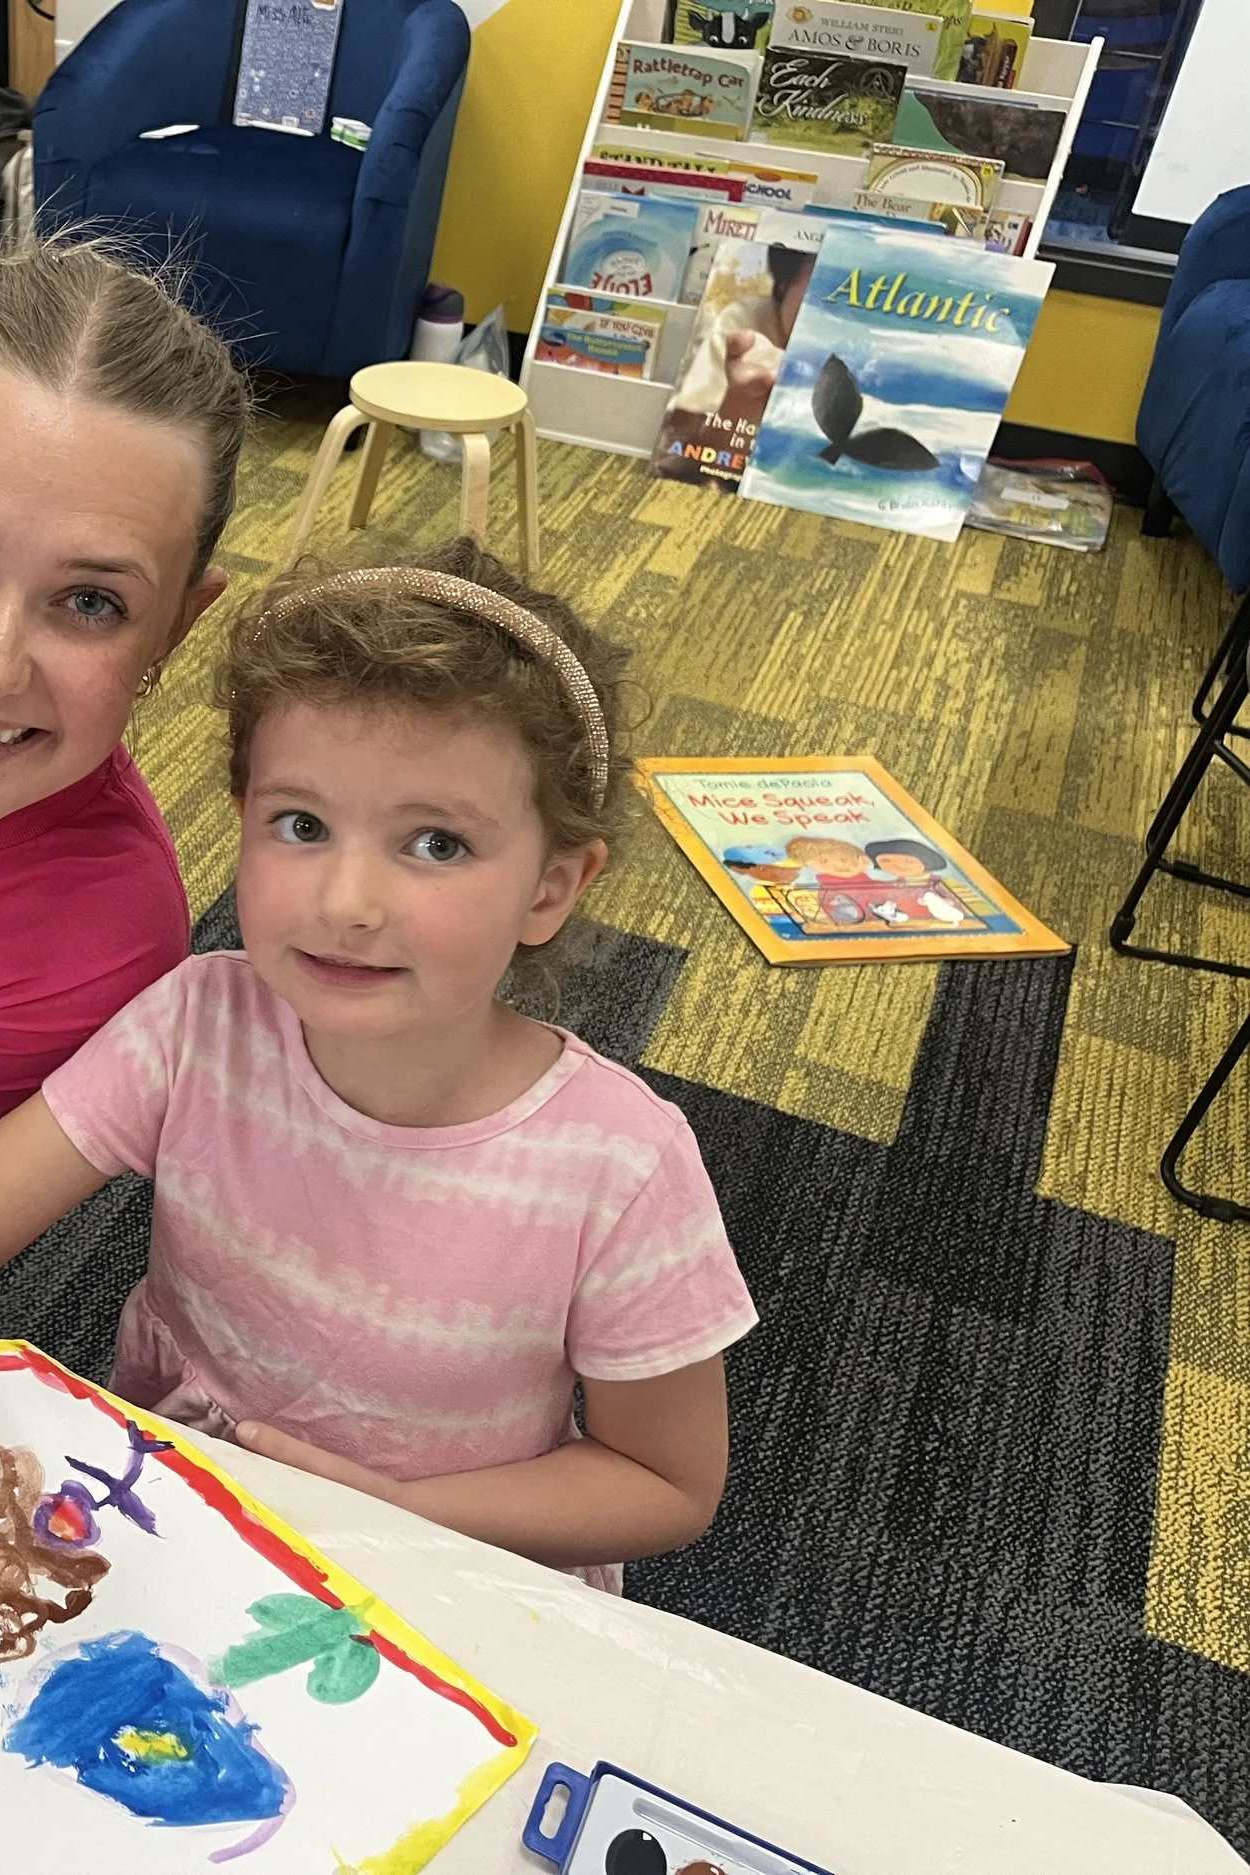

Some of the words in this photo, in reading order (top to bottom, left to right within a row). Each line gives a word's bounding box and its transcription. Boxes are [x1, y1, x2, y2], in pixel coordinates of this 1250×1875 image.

[820, 17, 869, 31] WILLIAM
[788, 28, 841, 47] AMOS
[845, 34, 864, 51] &
[867, 38, 921, 58] BORIS
[633, 57, 713, 87] Rattletrap
[718, 73, 745, 88] Car
[770, 58, 843, 89] Each
[757, 88, 868, 126] Kindness
[854, 193, 877, 208] The
[882, 198, 912, 212] Bear
[823, 266, 1011, 334] Atlantic
[599, 318, 611, 329] IF
[612, 320, 630, 332] YOU
[631, 323, 655, 338] GIVE
[705, 412, 733, 431] The
[730, 433, 745, 448] in
[667, 441, 748, 470] ANDRE
[693, 778, 751, 789] Tomie
[757, 778, 833, 789] dePaola
[687, 792, 757, 808] Mice
[762, 791, 875, 812] Squeak,
[718, 810, 769, 826] We
[772, 808, 871, 831] Speak
